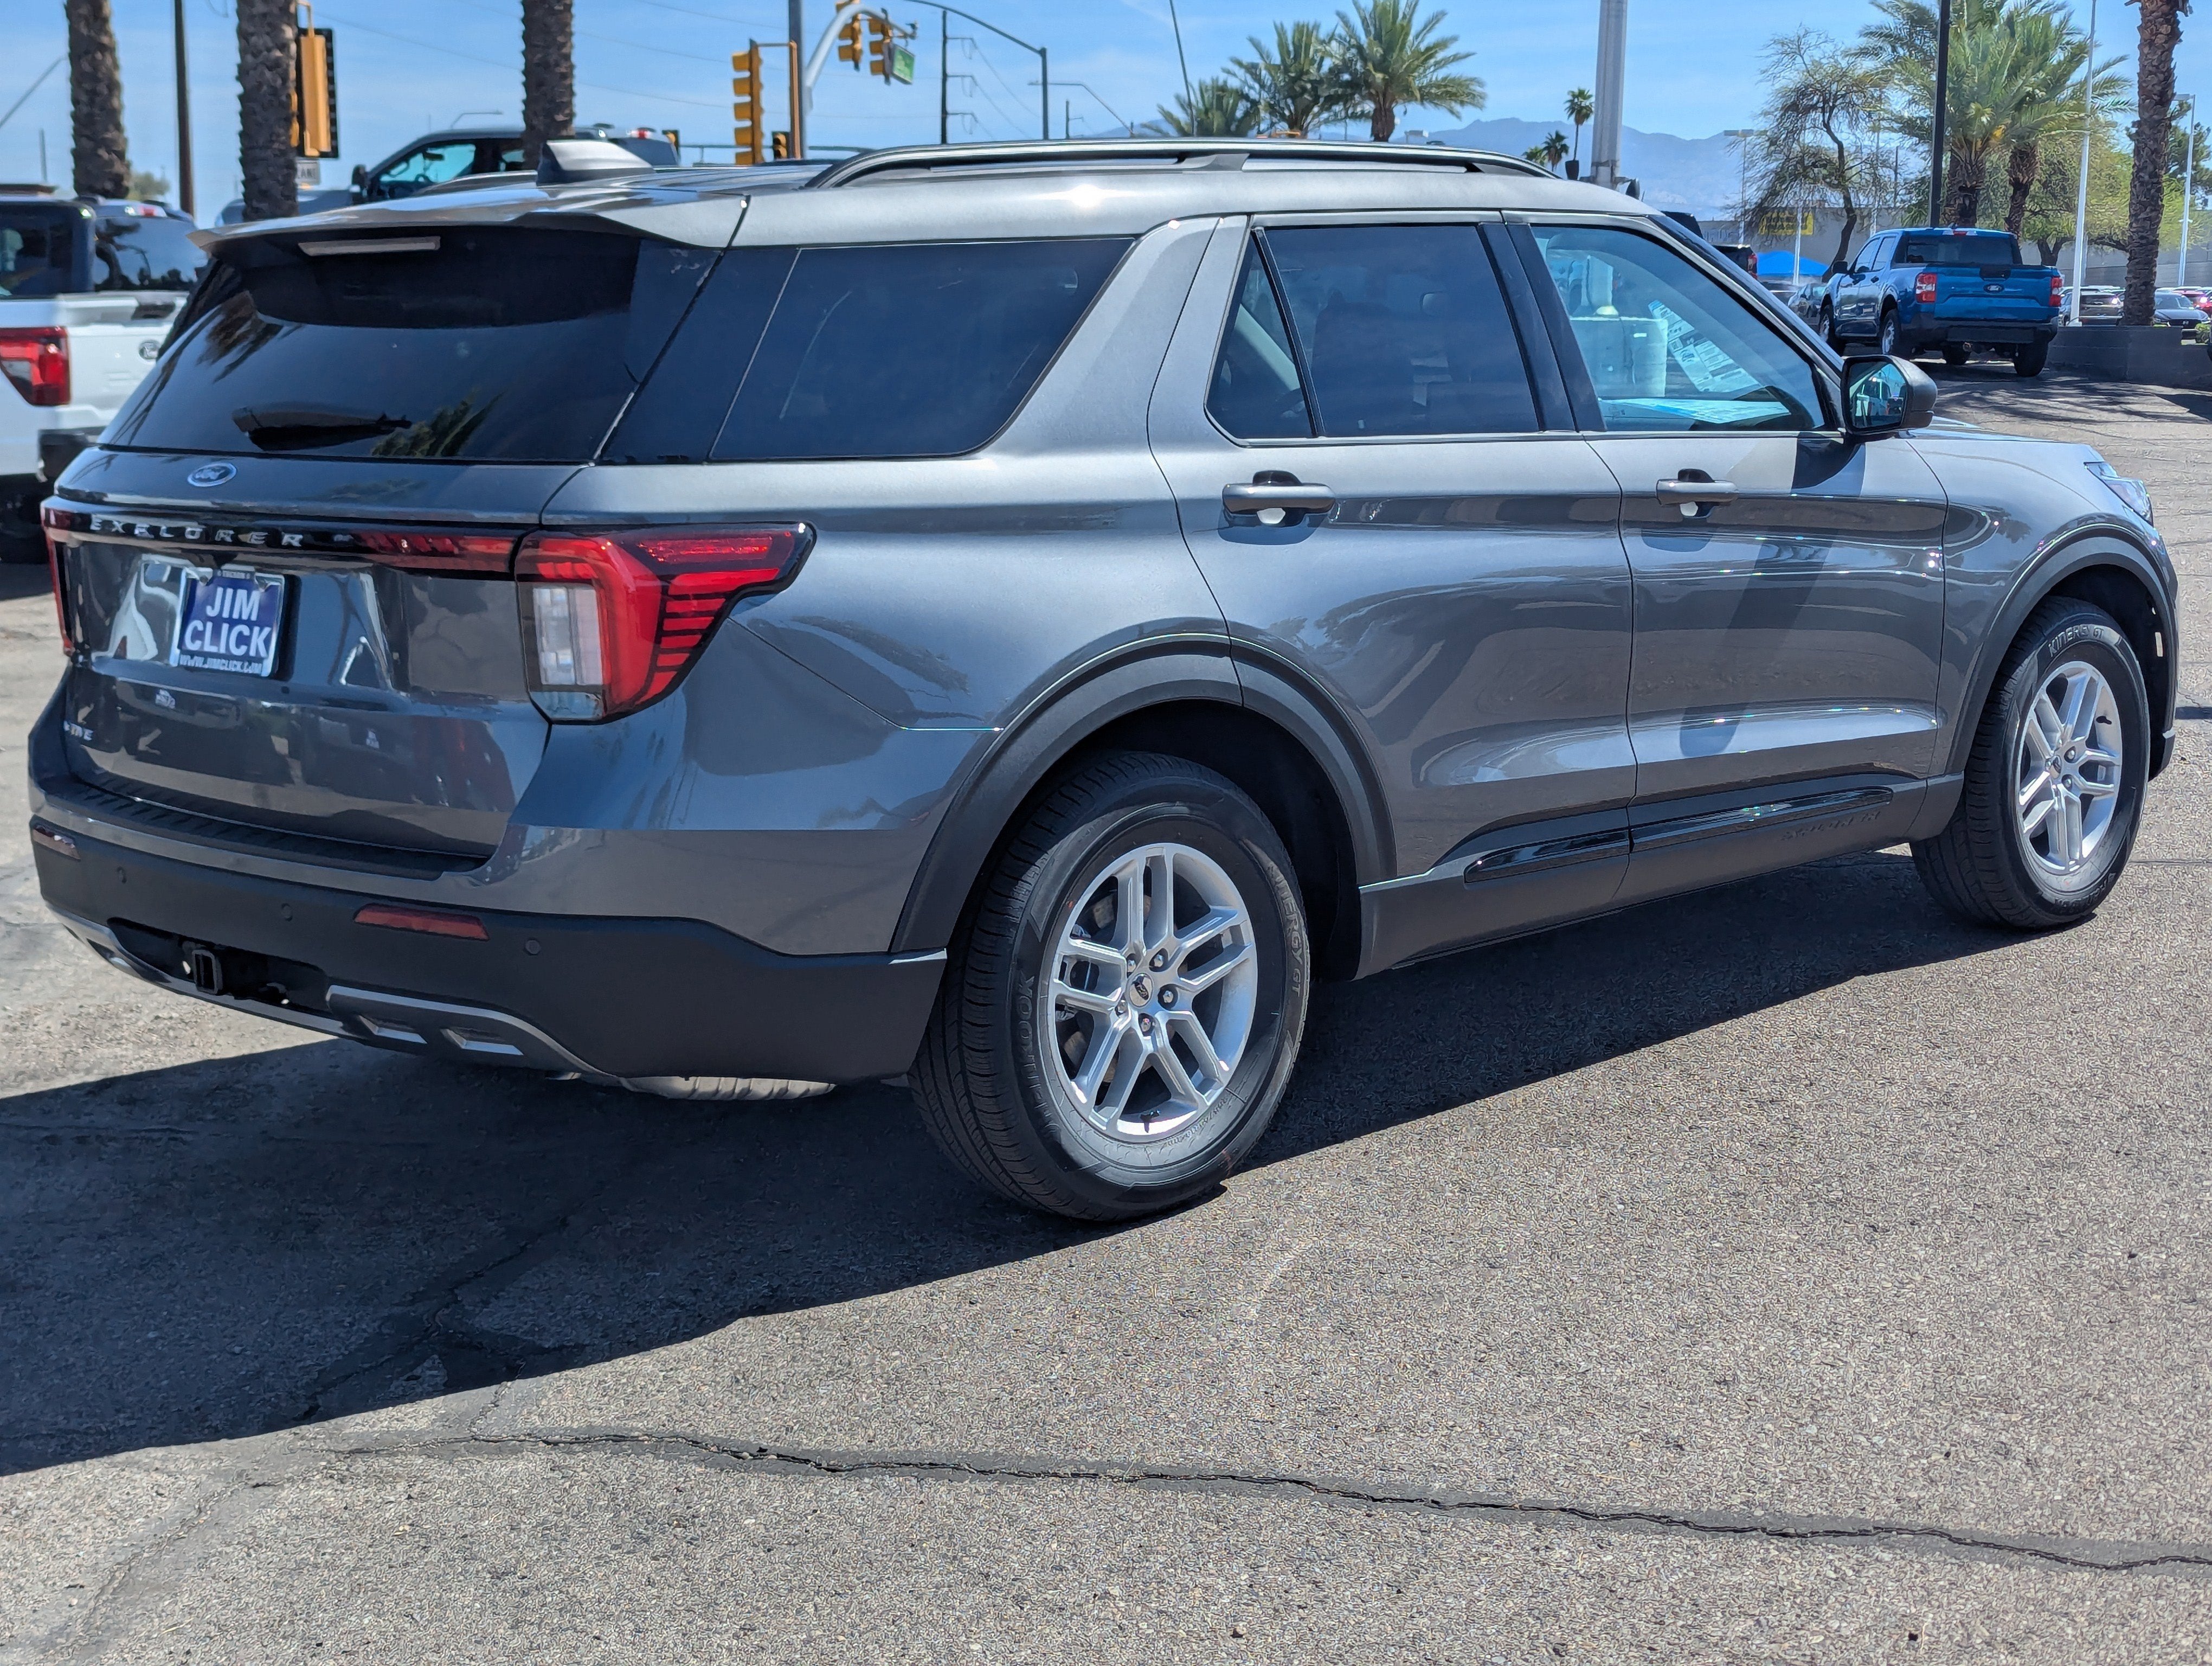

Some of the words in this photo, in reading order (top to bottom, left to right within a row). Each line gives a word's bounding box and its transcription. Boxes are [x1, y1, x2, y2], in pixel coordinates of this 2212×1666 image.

[90, 514, 304, 547] EXPLORER
[205, 586, 261, 621] JIM
[184, 619, 272, 658] CLICK
